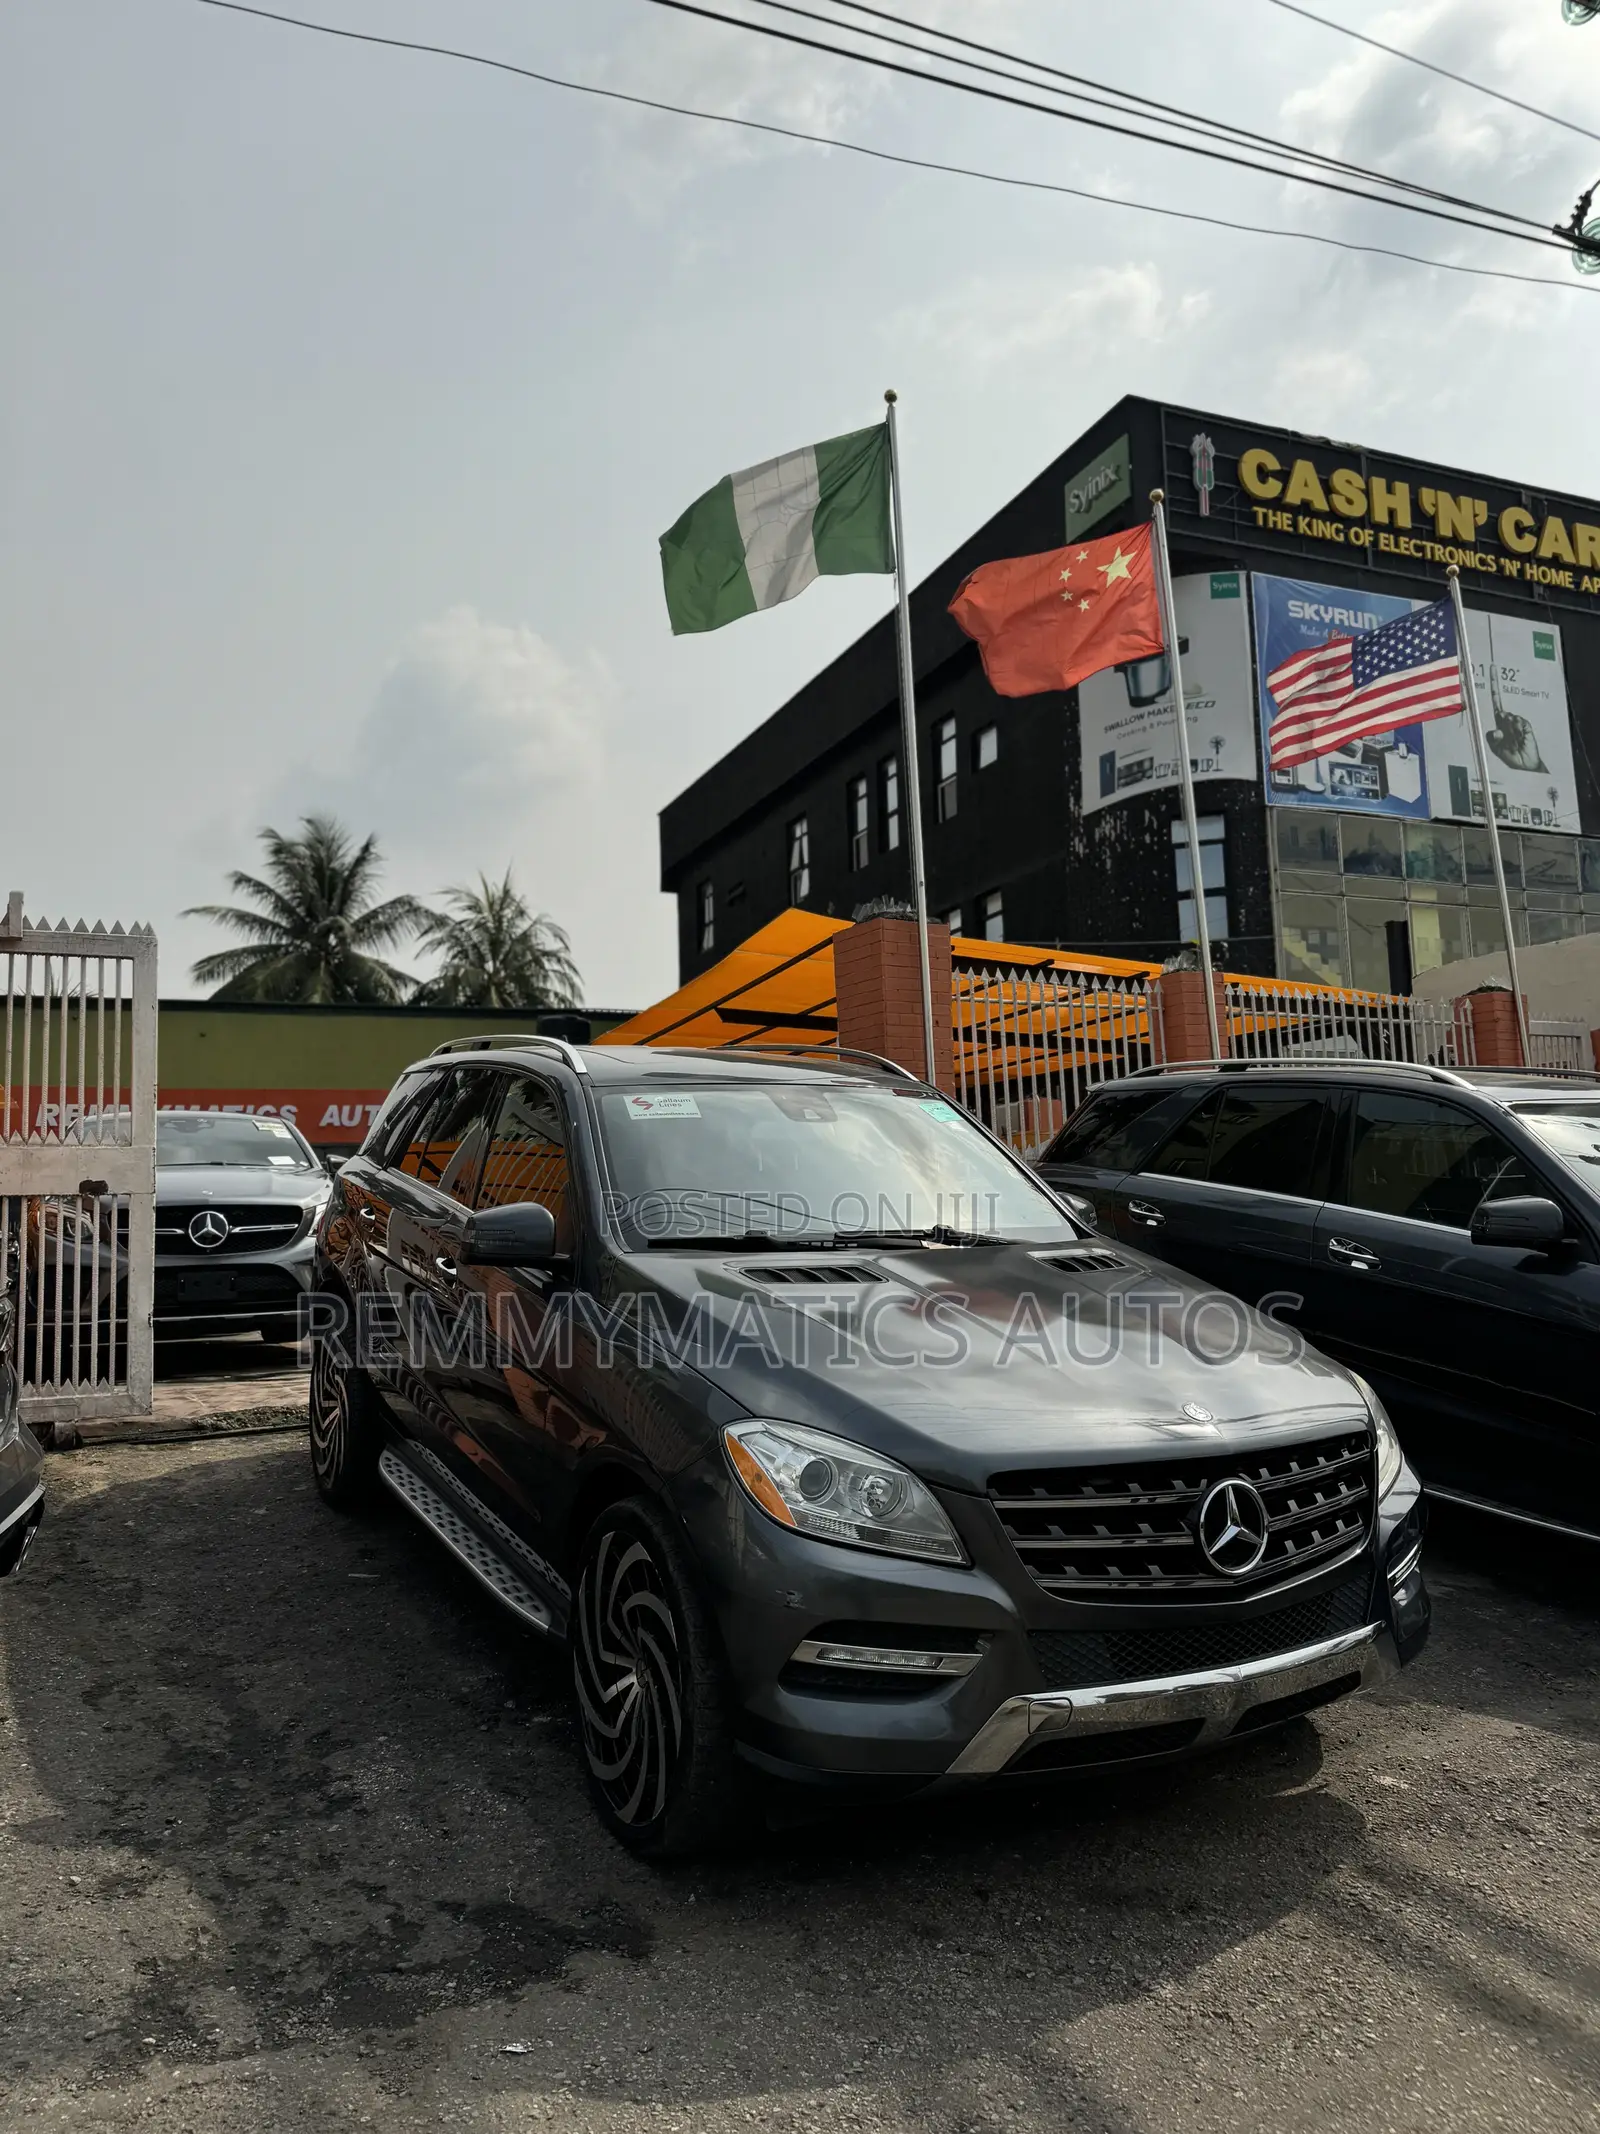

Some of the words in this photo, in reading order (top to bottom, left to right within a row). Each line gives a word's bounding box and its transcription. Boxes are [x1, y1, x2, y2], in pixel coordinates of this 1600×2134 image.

[1069, 462, 1119, 514] Syinix
[1238, 448, 1412, 529] CASH
[1252, 506, 1294, 532] THE
[1297, 515, 1344, 542] KING
[1349, 526, 1374, 547] OF
[1378, 532, 1497, 572] ELECTRONICS
[1524, 562, 1575, 589] HOME
[1287, 600, 1378, 630] SKYRUN
[1103, 712, 1146, 734] SWALLOW
[1147, 705, 1177, 719] MAKE
